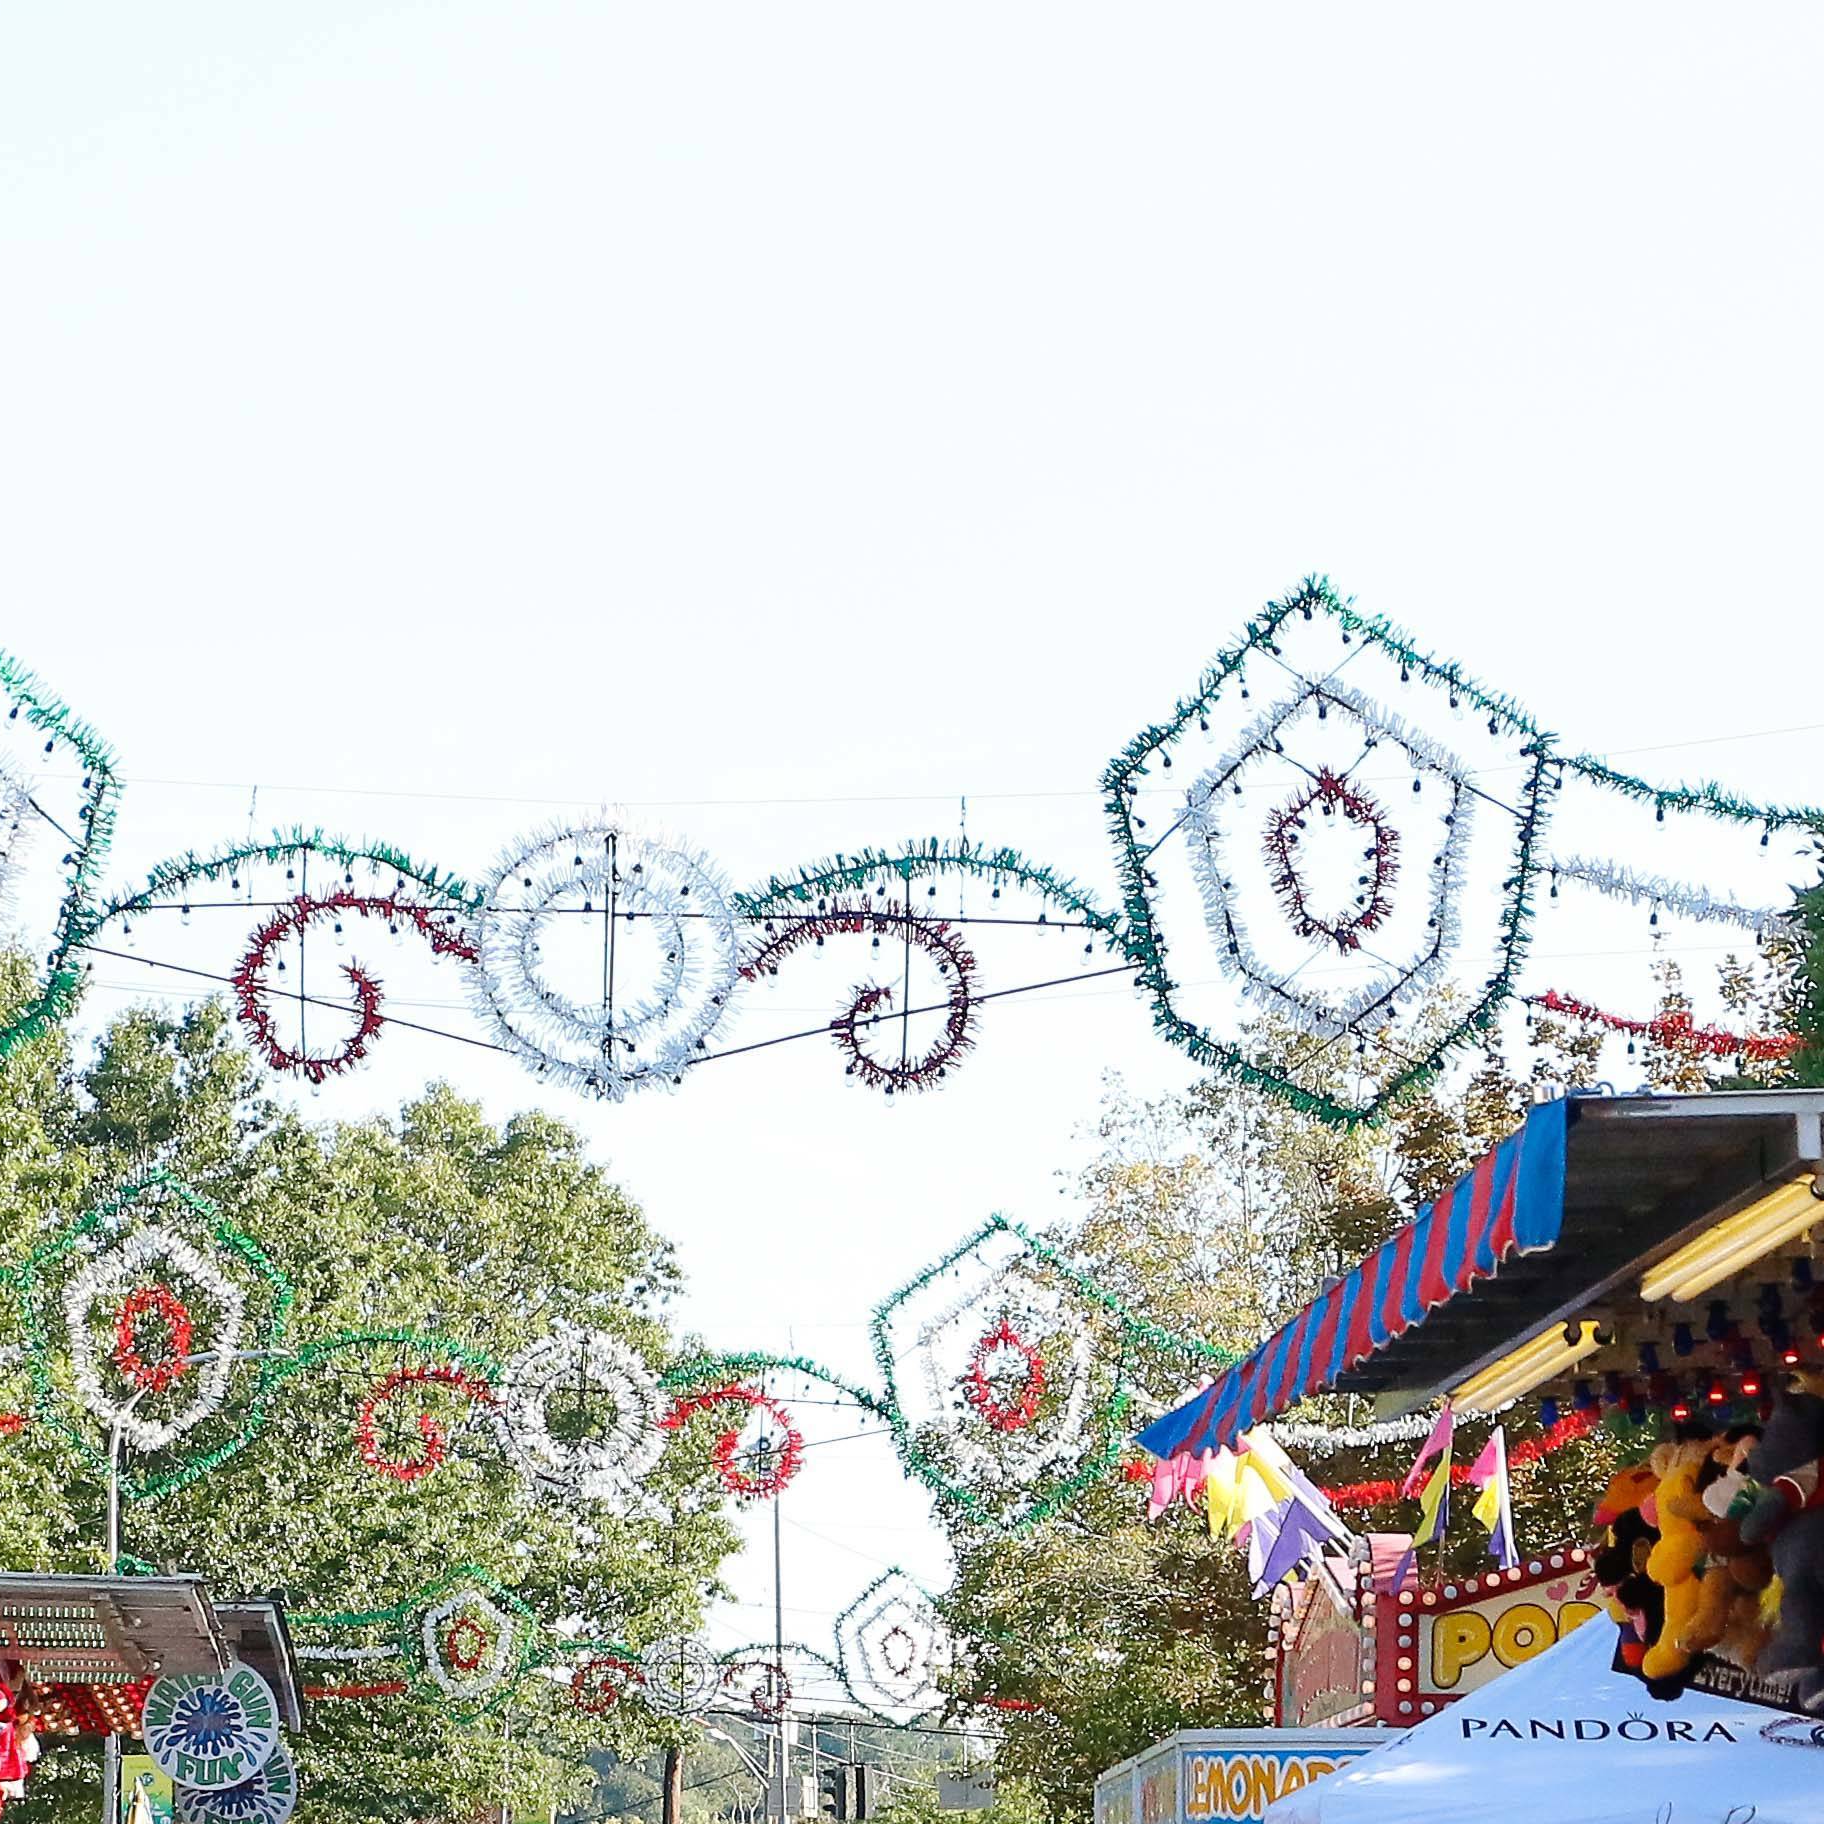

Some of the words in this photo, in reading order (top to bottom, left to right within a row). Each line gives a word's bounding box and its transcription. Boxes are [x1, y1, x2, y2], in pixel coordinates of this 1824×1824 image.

[228, 1670, 272, 1729] GUN
[175, 1751, 244, 1785] FUN
[263, 1754, 291, 1795] UN
